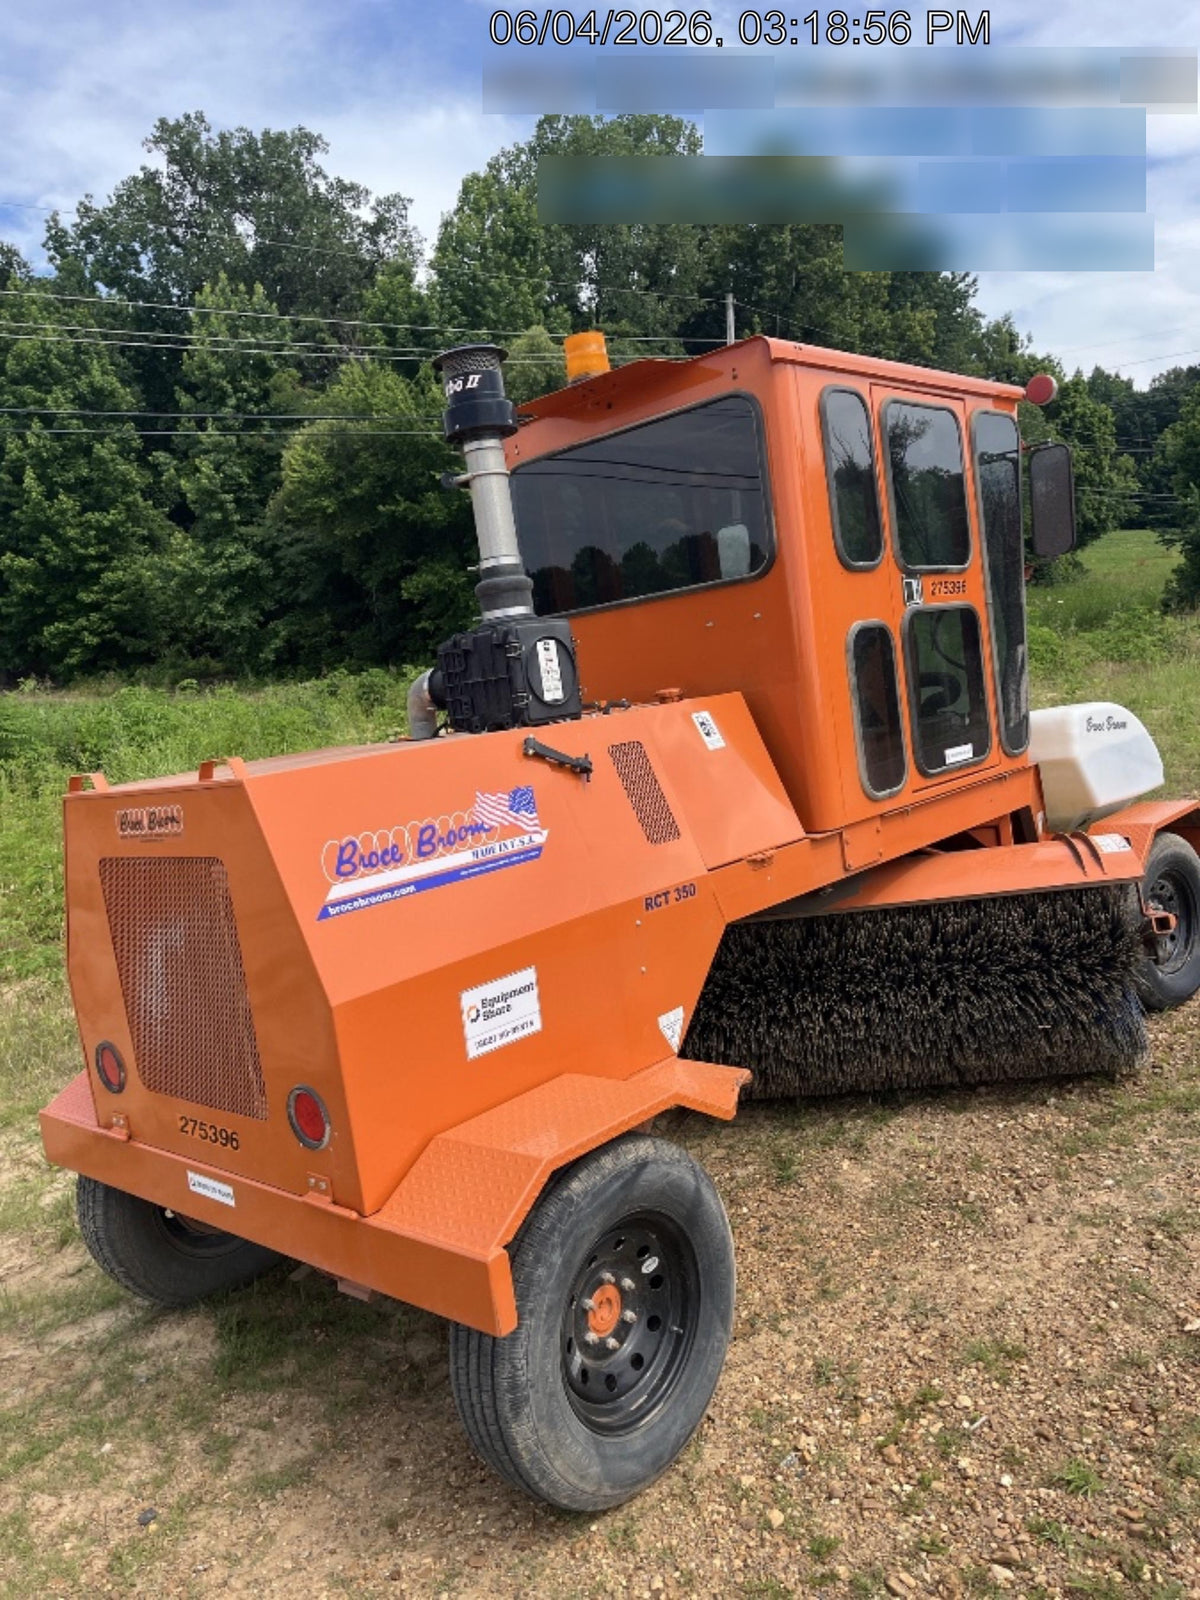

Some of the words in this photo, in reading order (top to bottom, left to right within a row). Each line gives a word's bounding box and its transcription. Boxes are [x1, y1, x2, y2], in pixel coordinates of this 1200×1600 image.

[931, 580, 966, 596] 275396
[335, 840, 404, 877] Broce
[417, 821, 492, 857] Broom
[328, 884, 416, 916] brocebroom.com
[645, 890, 670, 911] RCT
[674, 883, 696, 902] 350
[481, 982, 534, 1009] Equipment
[482, 1004, 512, 1021] Share
[179, 1116, 239, 1151] 275396
